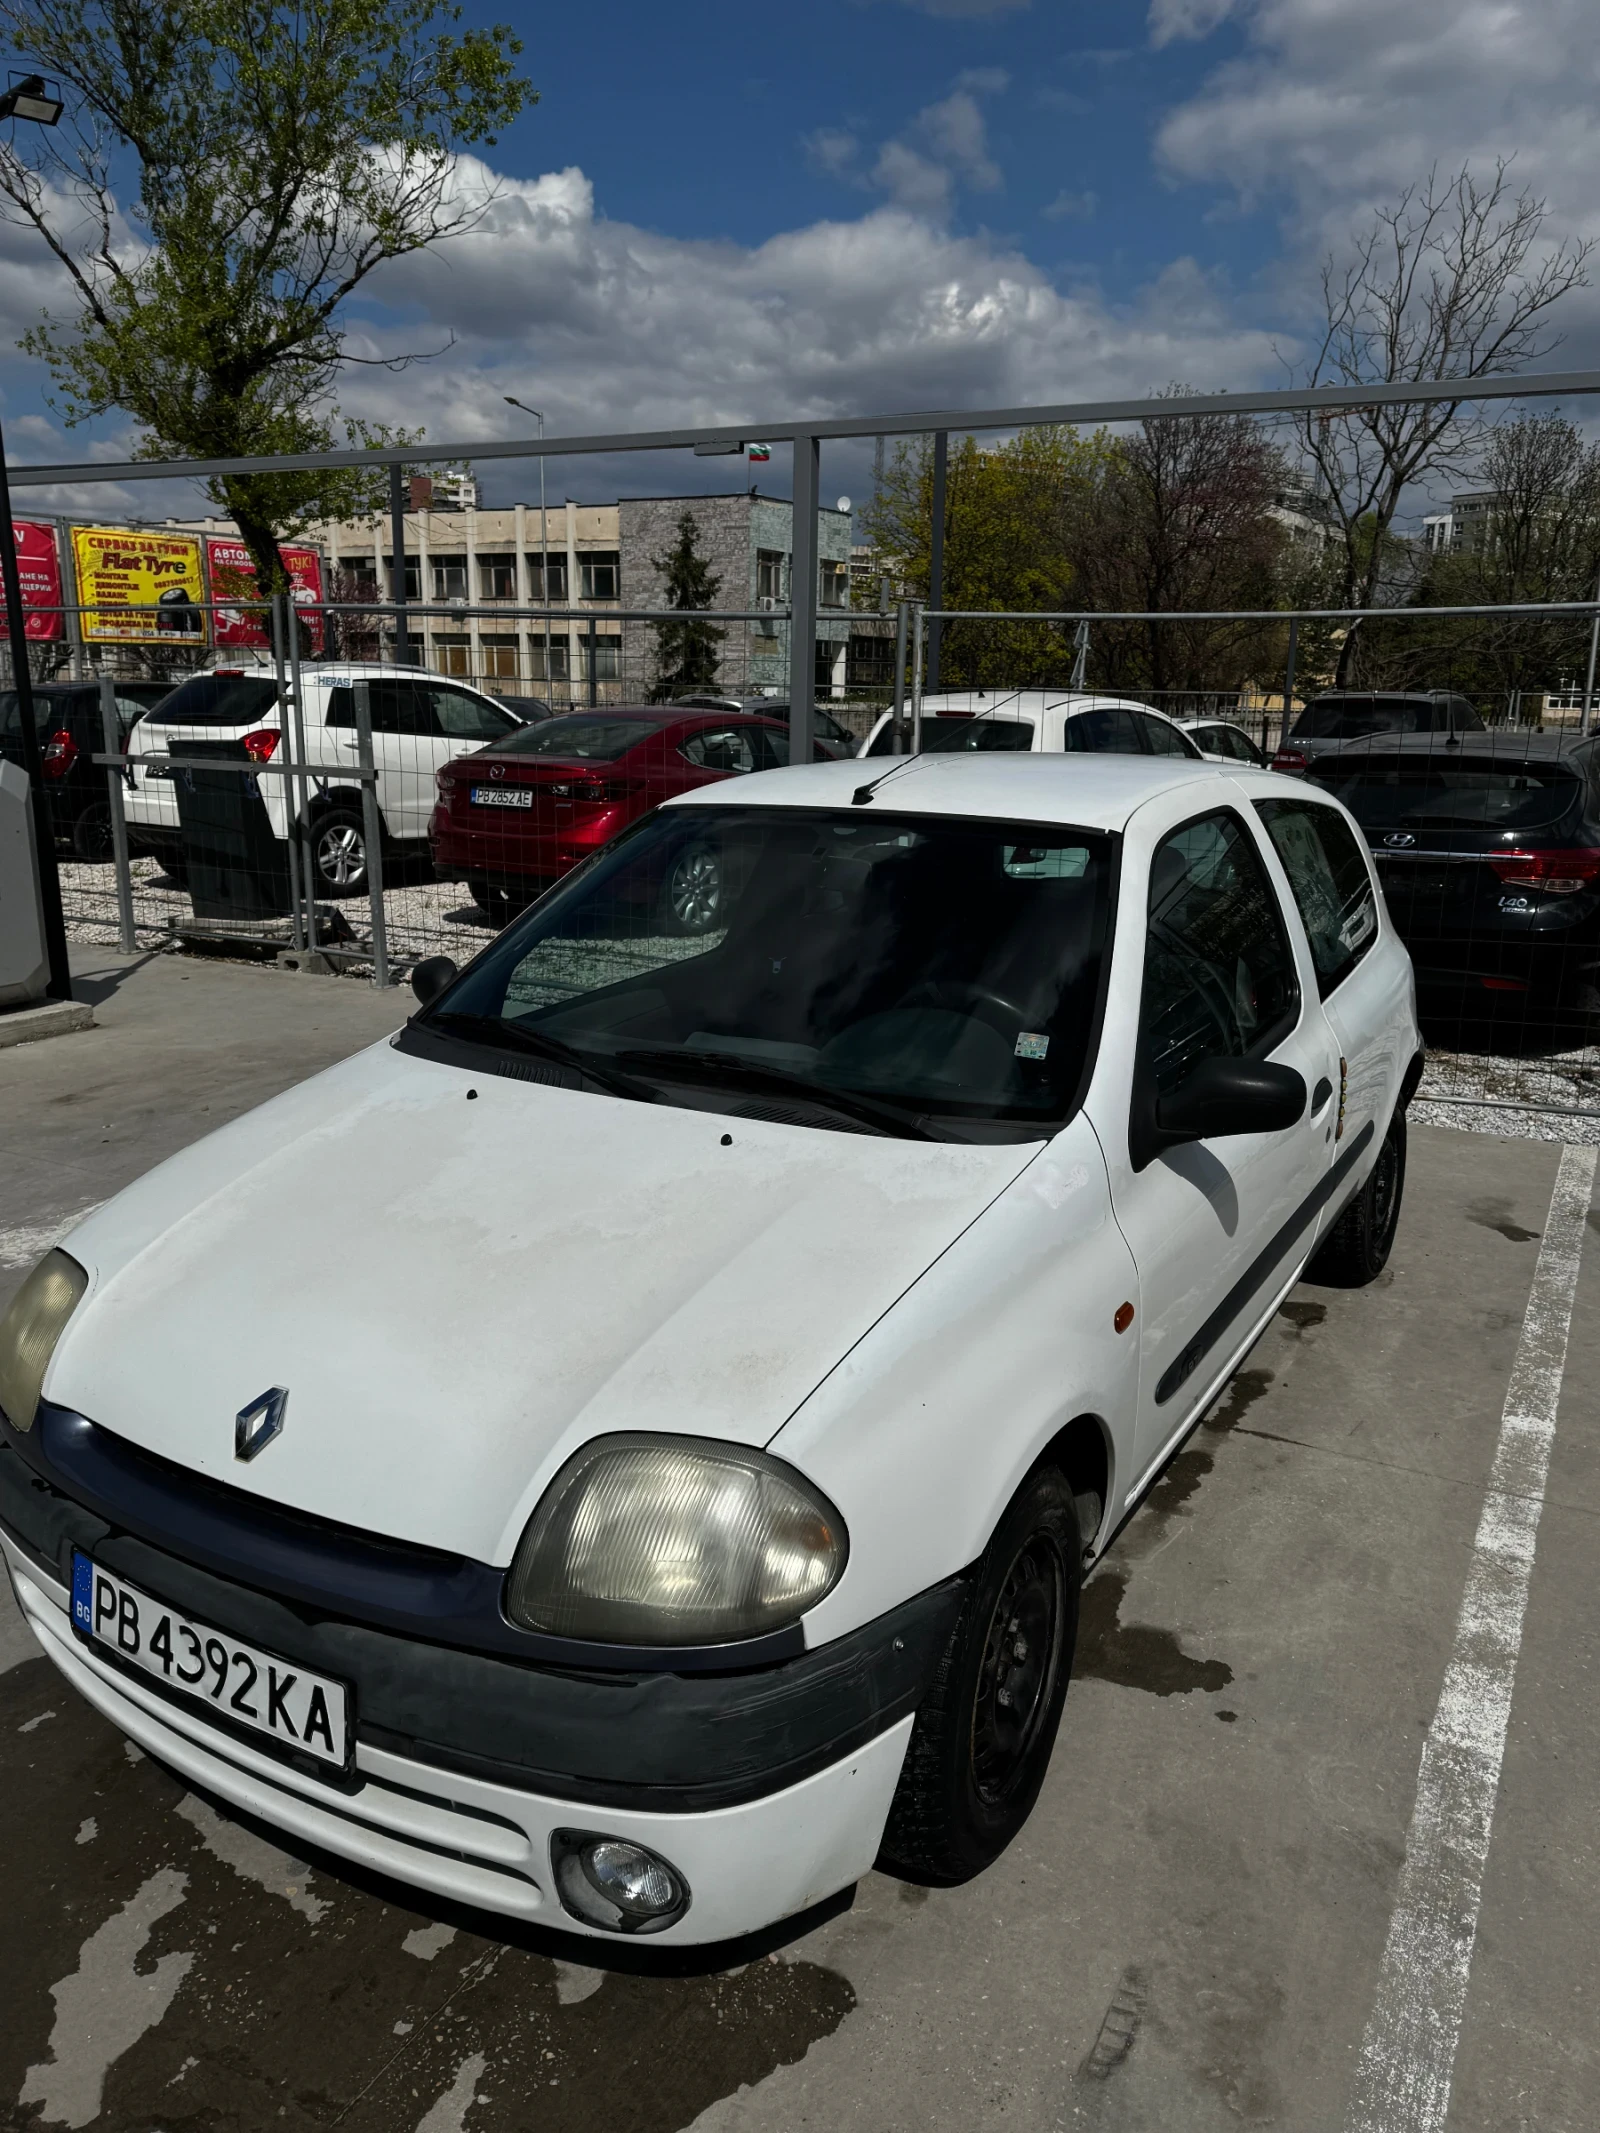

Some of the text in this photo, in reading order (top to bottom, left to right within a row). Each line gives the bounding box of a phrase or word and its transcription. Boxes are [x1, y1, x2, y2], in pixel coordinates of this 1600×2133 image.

[88, 537, 189, 556] СЕРВИЗ ЗА ГУМИ
[214, 548, 251, 560] АВТОМ
[102, 552, 187, 576] Flat Tyre
[289, 555, 313, 570] ТУК!
[37, 573, 49, 581] НА
[318, 676, 351, 687] HERAS
[76, 1600, 91, 1623] BG
